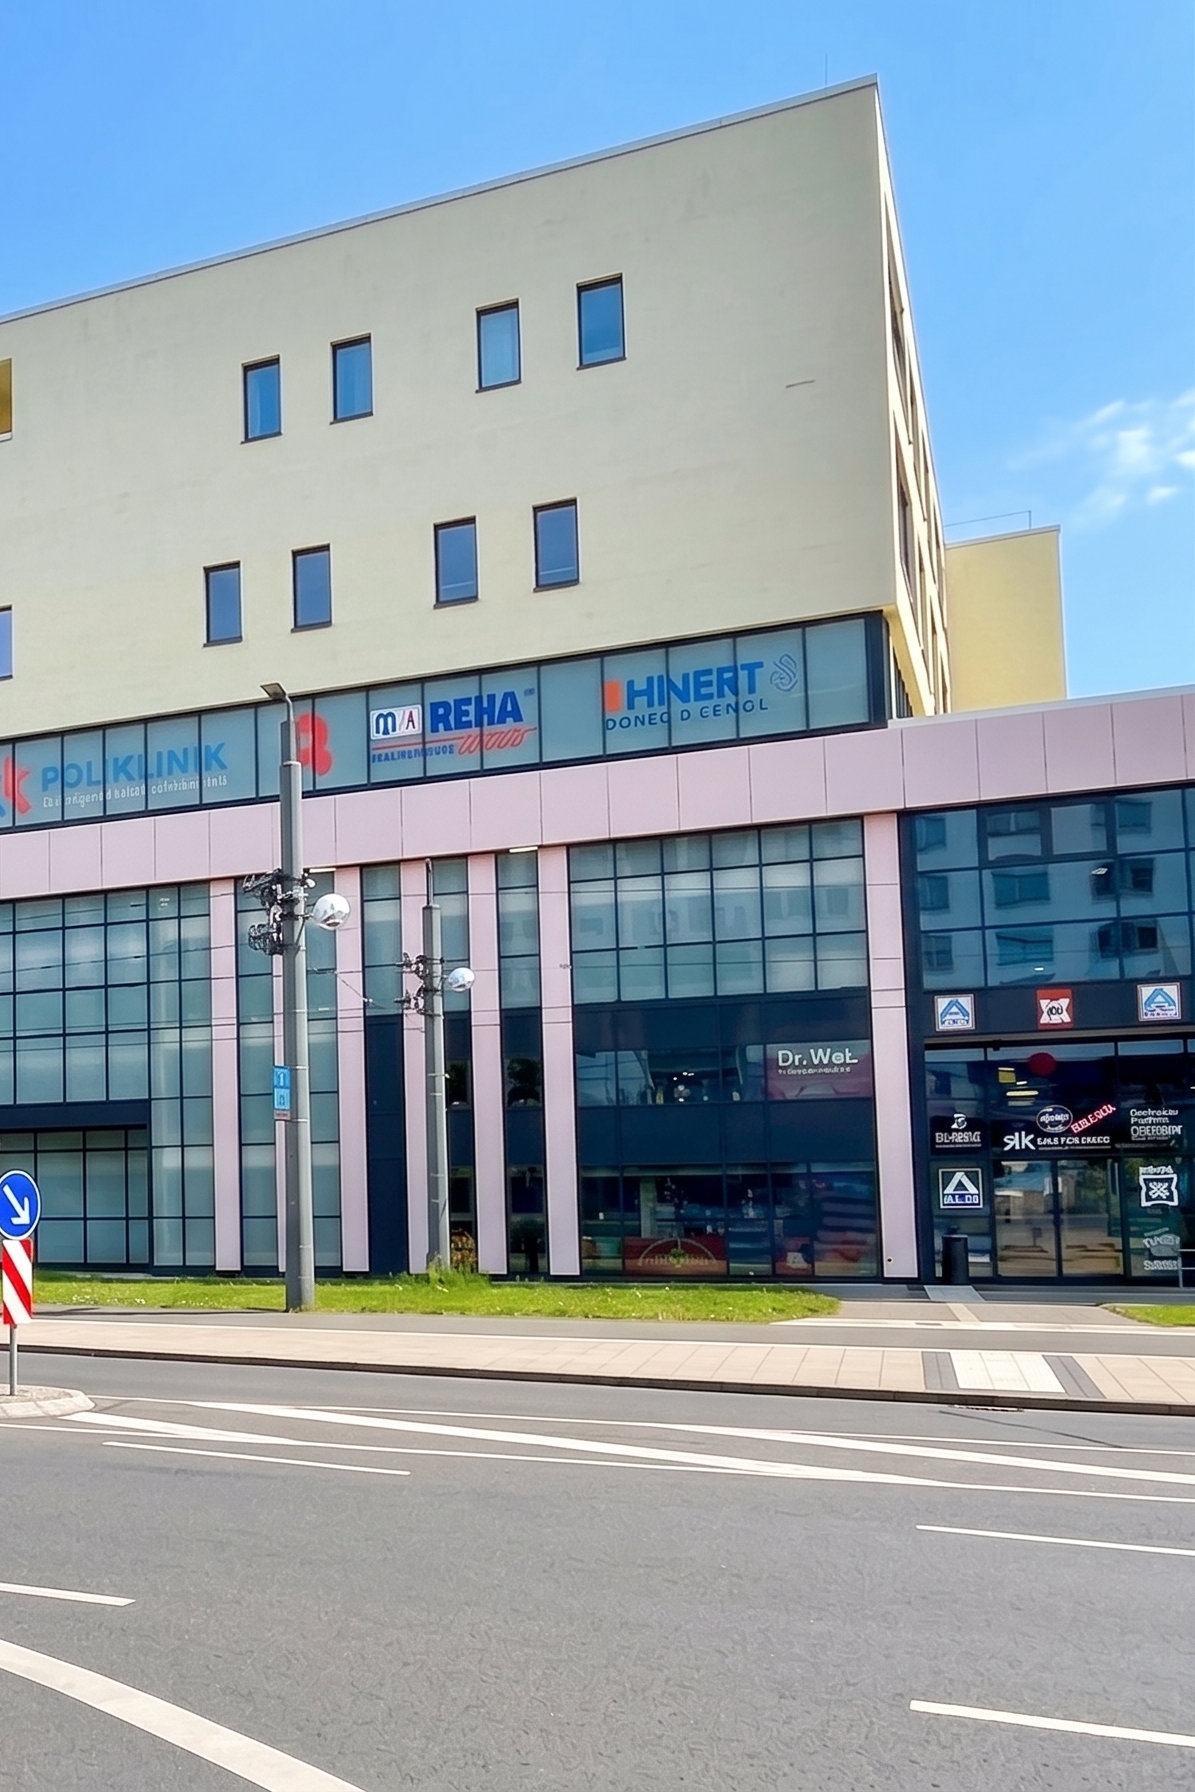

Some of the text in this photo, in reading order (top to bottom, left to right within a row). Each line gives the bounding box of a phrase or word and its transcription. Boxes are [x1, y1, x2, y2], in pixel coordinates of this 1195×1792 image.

[429, 690, 524, 733] REHA
[41, 742, 228, 792] POLIKLINIK
[778, 1050, 807, 1066] Dr.
